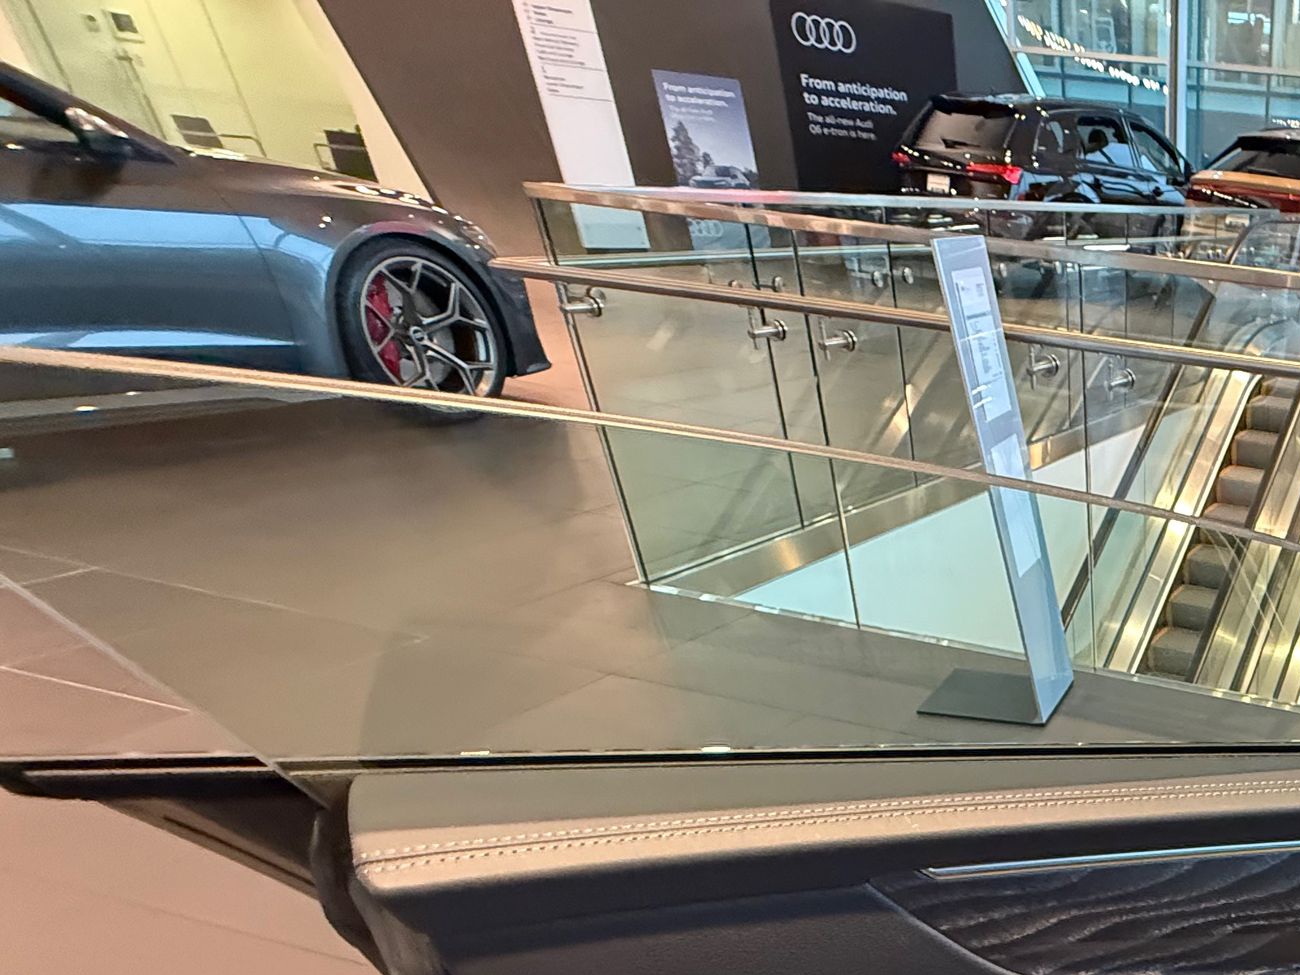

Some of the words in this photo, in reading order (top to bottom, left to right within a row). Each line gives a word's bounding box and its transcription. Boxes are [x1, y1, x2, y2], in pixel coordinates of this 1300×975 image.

[800, 73, 835, 90] From
[837, 82, 908, 101] anticipation
[803, 92, 819, 105] to
[821, 96, 897, 115] acceleration.
[807, 112, 823, 122] The
[855, 118, 874, 129] Audi
